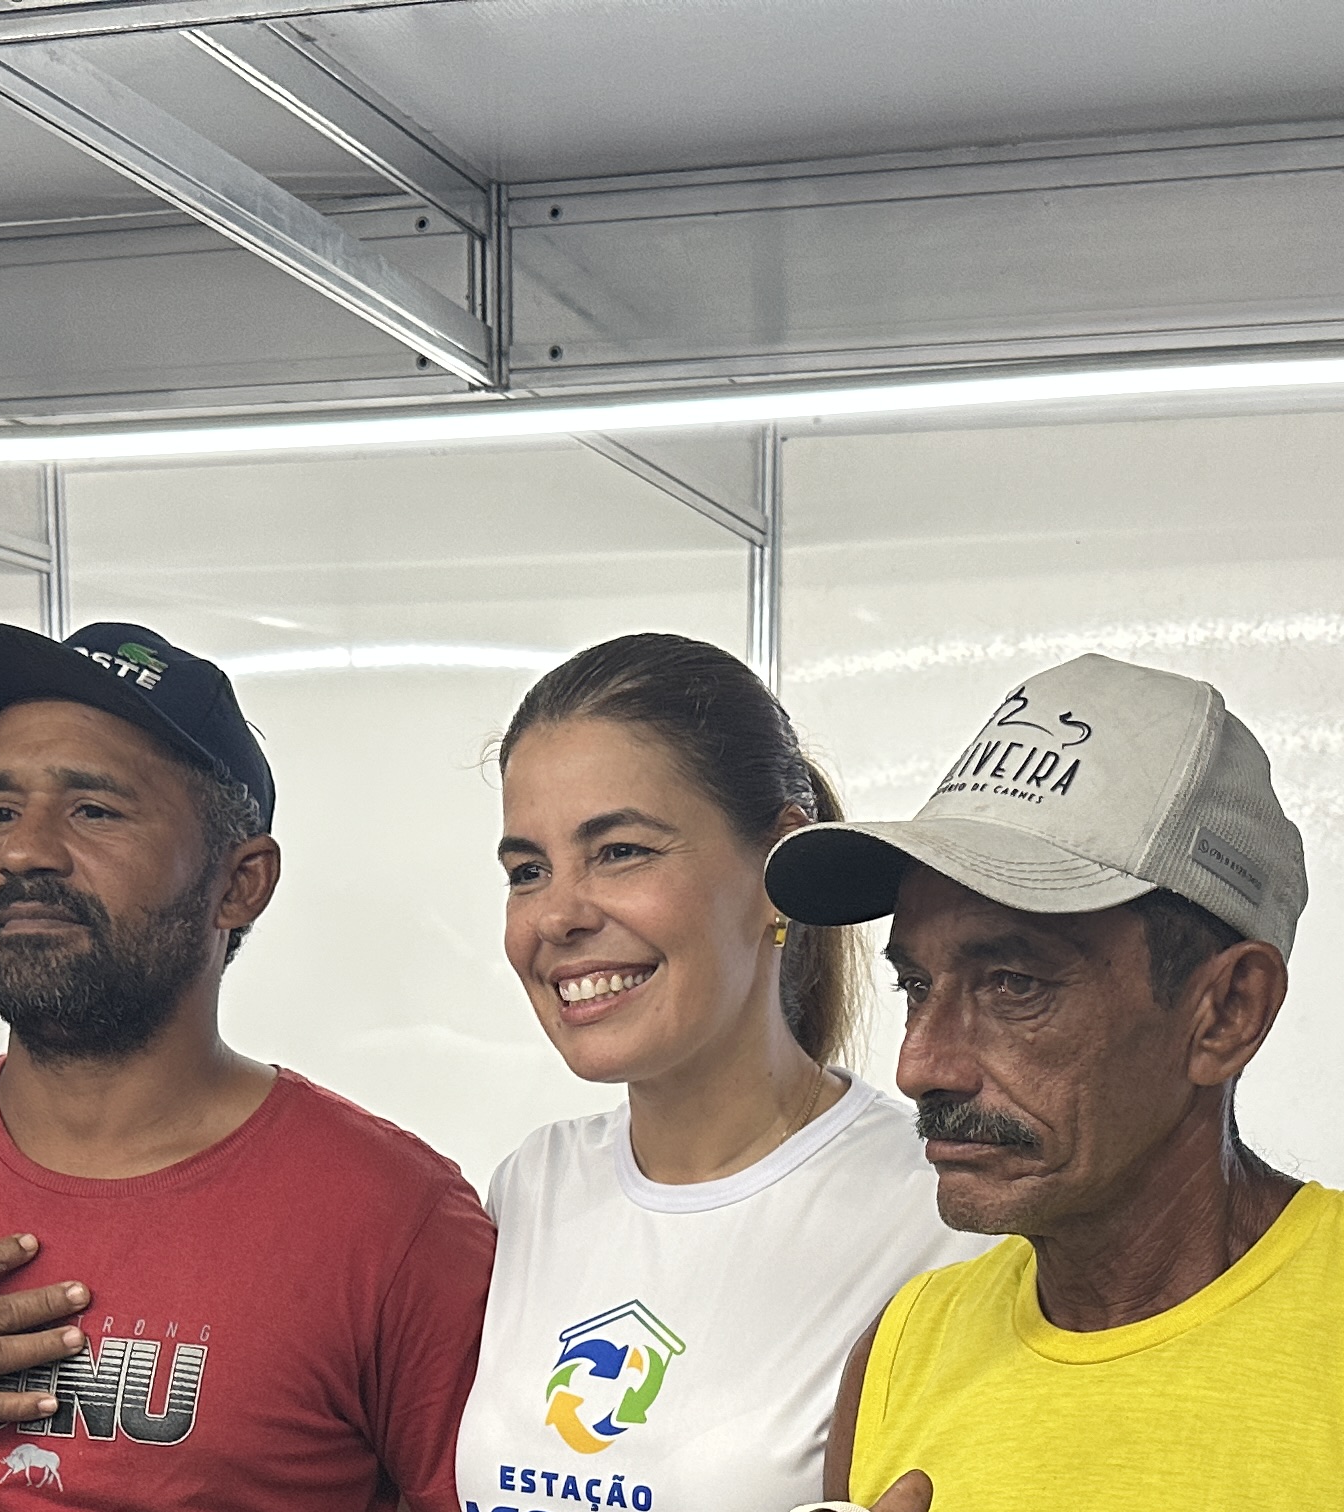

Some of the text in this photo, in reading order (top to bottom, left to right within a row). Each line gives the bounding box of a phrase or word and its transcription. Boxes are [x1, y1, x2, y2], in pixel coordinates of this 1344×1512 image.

[993, 785, 1045, 804] CARNES
[78, 1315, 212, 1343] TRONG
[499, 1464, 653, 1512] ESTAÇÃO
